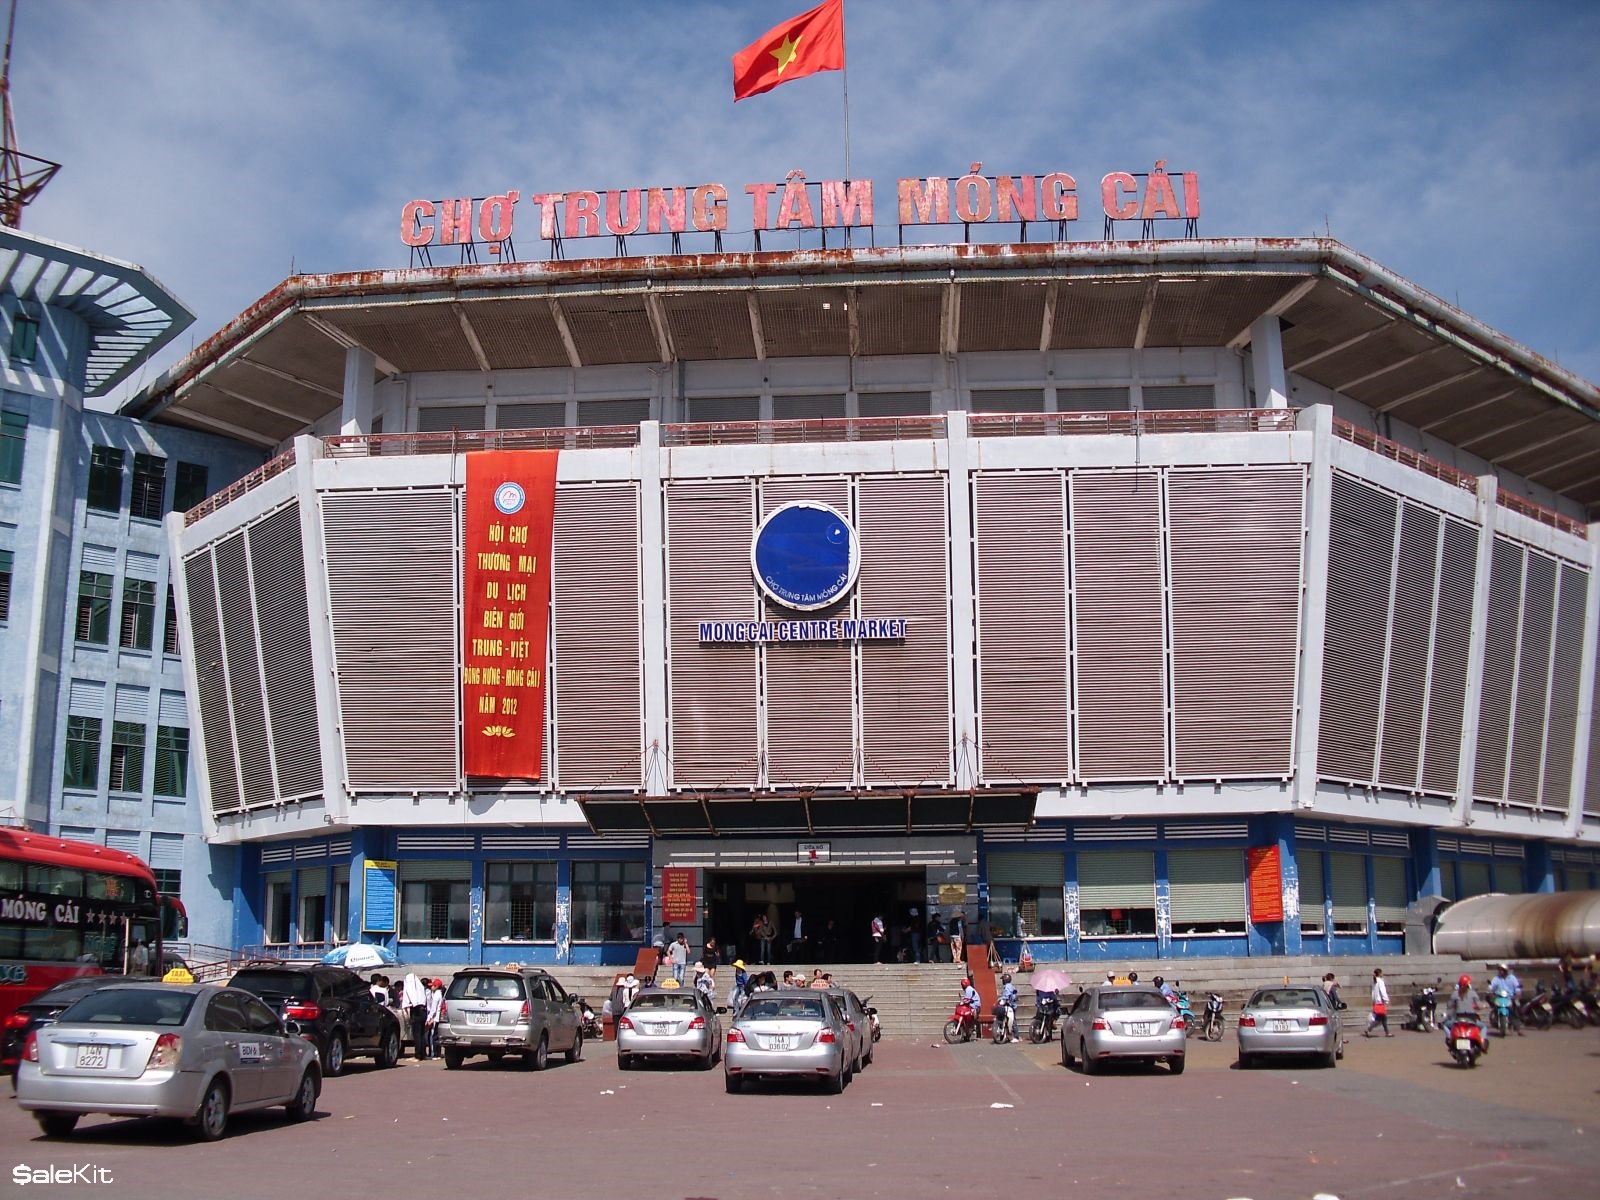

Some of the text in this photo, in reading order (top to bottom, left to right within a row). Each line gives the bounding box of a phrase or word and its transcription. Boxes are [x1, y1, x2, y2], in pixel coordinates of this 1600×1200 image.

[401, 159, 1200, 255] CHỢ TRUNG TÂM MÓNG CÁI
[488, 521, 528, 548] HỘI CHỢ
[477, 552, 537, 577] THƯƠNG MẠI
[486, 581, 527, 604] DU LỊCH
[778, 587, 801, 601] TRUNG
[483, 607, 525, 630] BIÊN GIỚI
[699, 618, 907, 642] MONG CAI CENTRE MARKET
[501, 697, 518, 715] 2012
[1, 894, 80, 923] MÓNG CÁI
[79, 1055, 104, 1067] 8272
